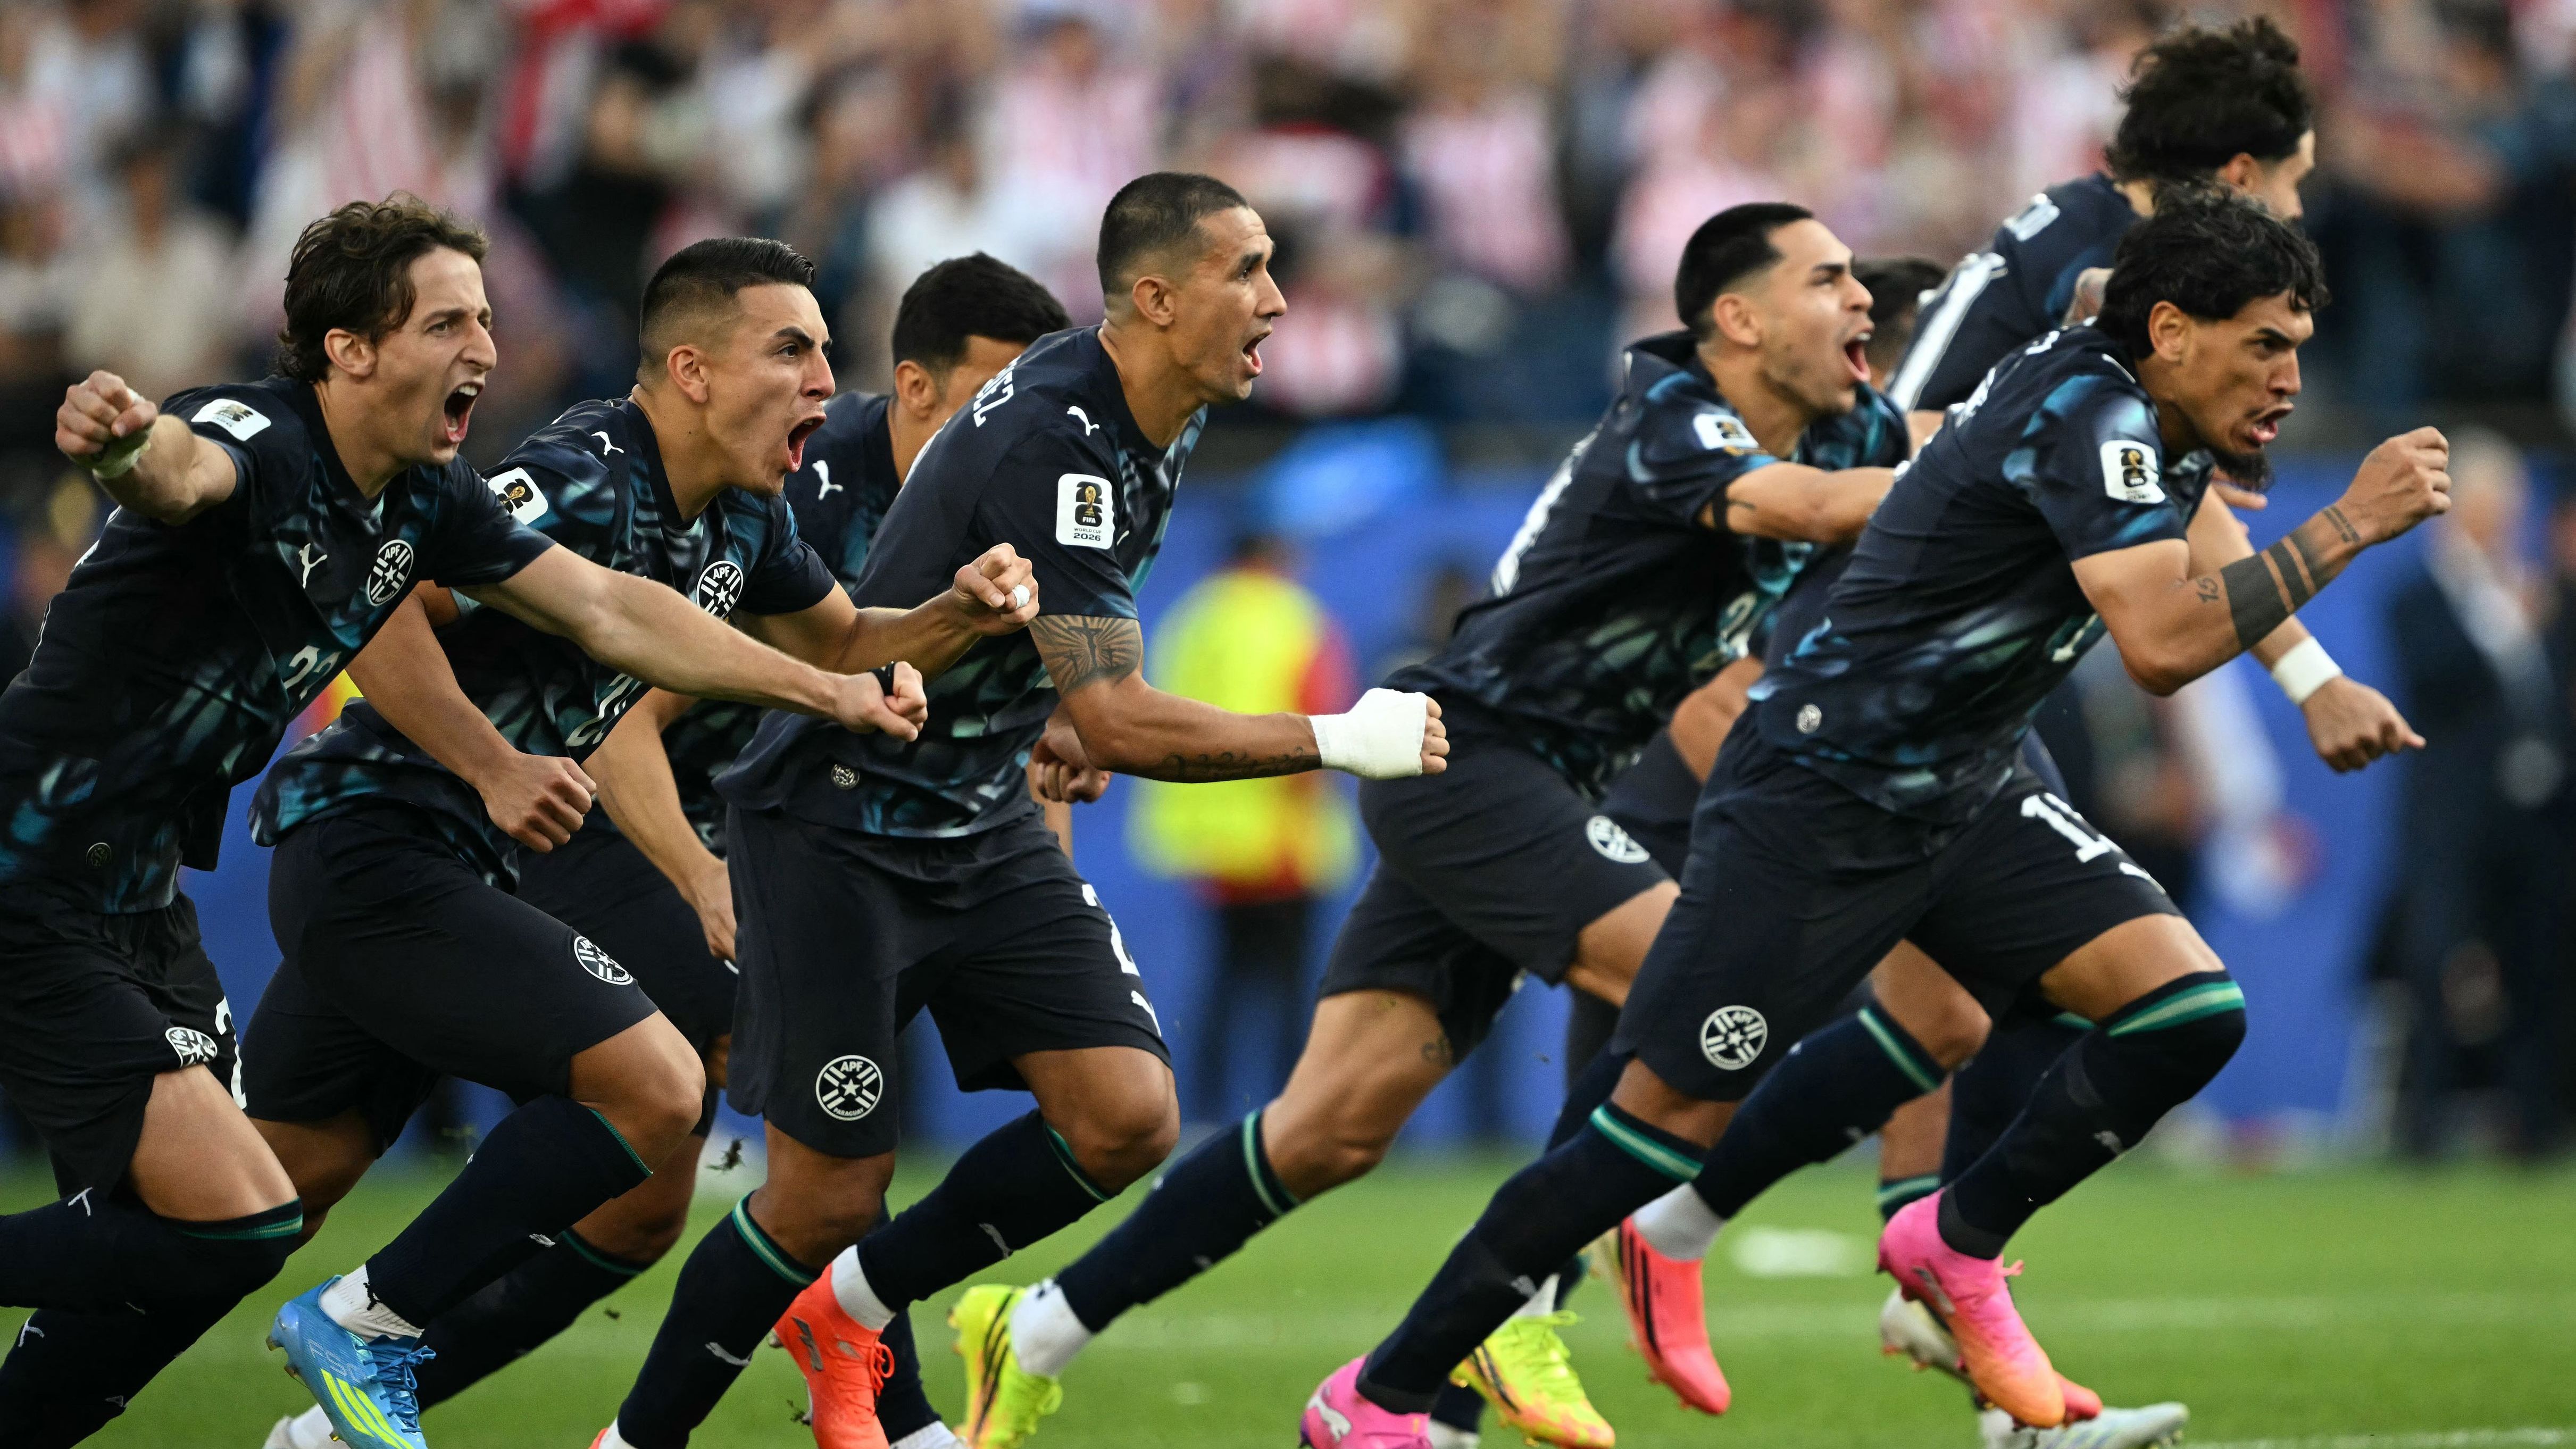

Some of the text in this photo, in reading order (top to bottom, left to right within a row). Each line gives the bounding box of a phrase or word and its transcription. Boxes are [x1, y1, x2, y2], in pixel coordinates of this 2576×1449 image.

[1073, 532, 1101, 541] 2026
[384, 544, 401, 560] APF
[713, 565, 730, 579] APF
[840, 1061, 864, 1072] APF
[833, 1107, 864, 1117] PARAGUAY
